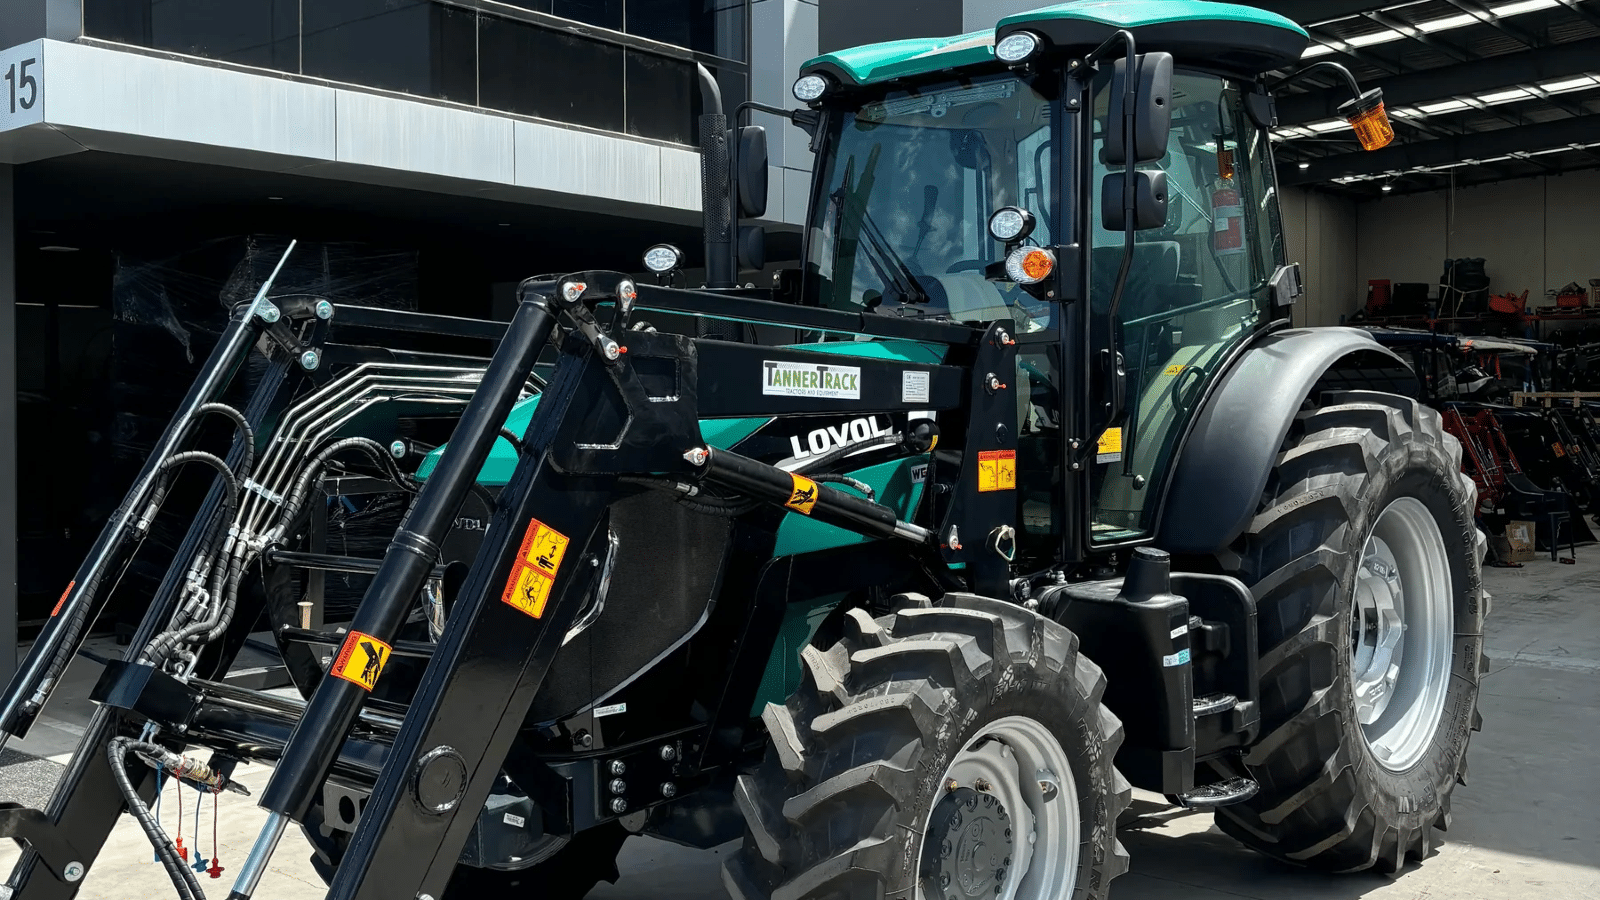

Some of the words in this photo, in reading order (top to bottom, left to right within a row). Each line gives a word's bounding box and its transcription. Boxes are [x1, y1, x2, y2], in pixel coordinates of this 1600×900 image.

[5, 58, 36, 114] 15
[790, 416, 886, 460] LOVOL
[912, 467, 928, 480] WE
